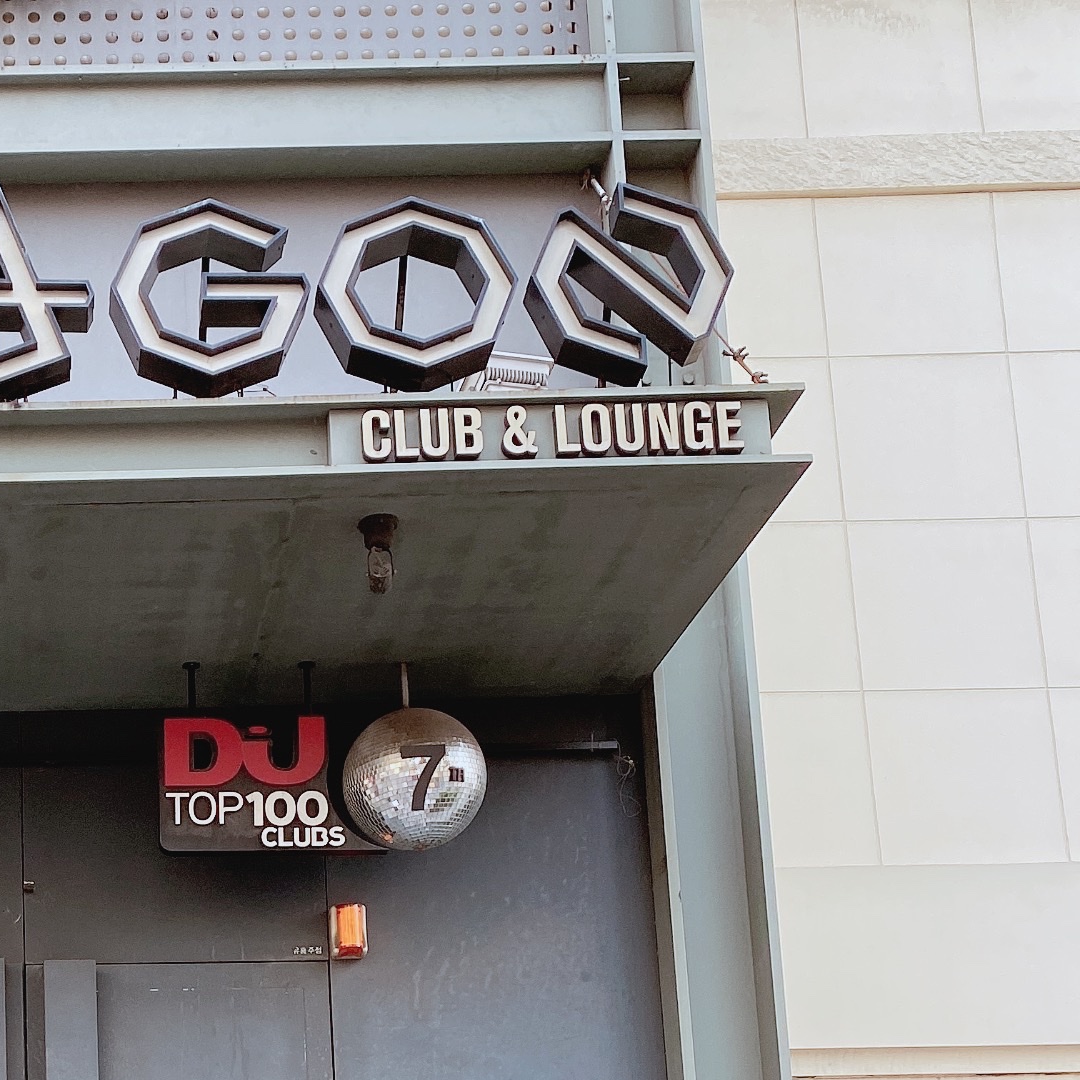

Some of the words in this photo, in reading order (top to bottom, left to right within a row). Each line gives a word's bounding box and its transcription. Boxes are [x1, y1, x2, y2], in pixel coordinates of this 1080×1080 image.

[361, 406, 485, 463] CLUB
[501, 404, 539, 460] &
[551, 401, 745, 460] LOUNGE
[164, 716, 326, 786] DJ
[260, 826, 346, 848] CLUBS
